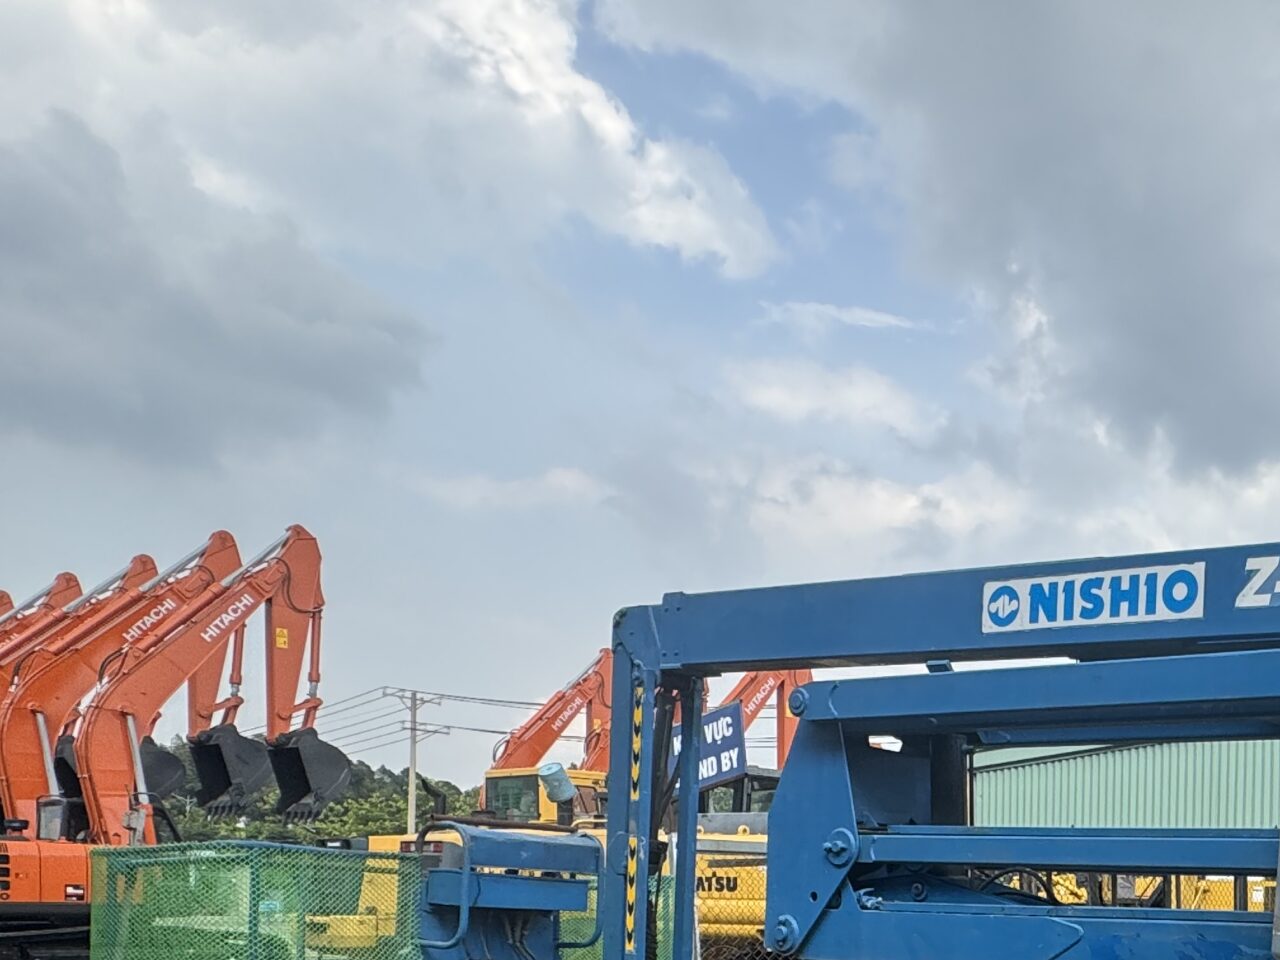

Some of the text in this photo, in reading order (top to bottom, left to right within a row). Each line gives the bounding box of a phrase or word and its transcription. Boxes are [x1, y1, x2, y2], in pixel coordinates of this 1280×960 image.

[1029, 568, 1199, 626] NISHIO
[122, 598, 177, 643] HITACHI
[200, 593, 255, 643] HITACHI
[551, 698, 583, 732] HITACHI
[744, 677, 775, 715] HITACHI
[704, 716, 734, 745] VỰC
[720, 747, 739, 773] BY
